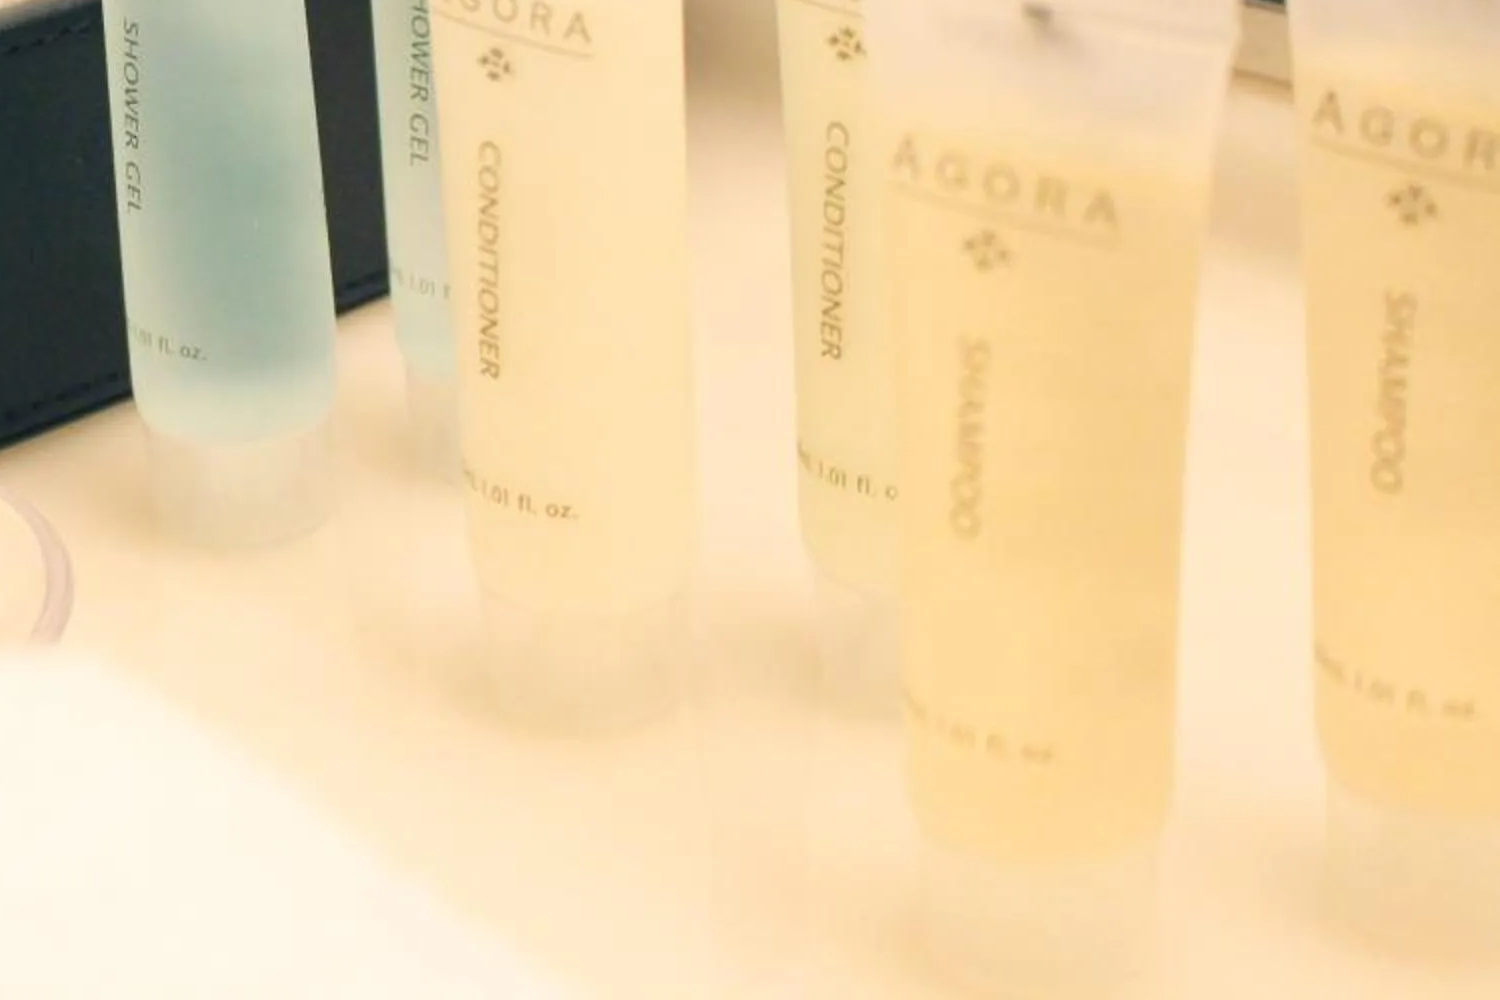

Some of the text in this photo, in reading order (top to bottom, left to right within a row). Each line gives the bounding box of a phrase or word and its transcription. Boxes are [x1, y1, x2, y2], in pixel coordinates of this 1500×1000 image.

[123, 16, 143, 214] SHOWER GEL
[409, 112, 429, 167] GEL
[891, 133, 1117, 228] AGORA
[478, 140, 501, 381] CONDITIONER
[820, 120, 850, 361] CONDITIONER
[1370, 286, 1418, 495] SHAMPOO
[545, 503, 580, 520] oz.
